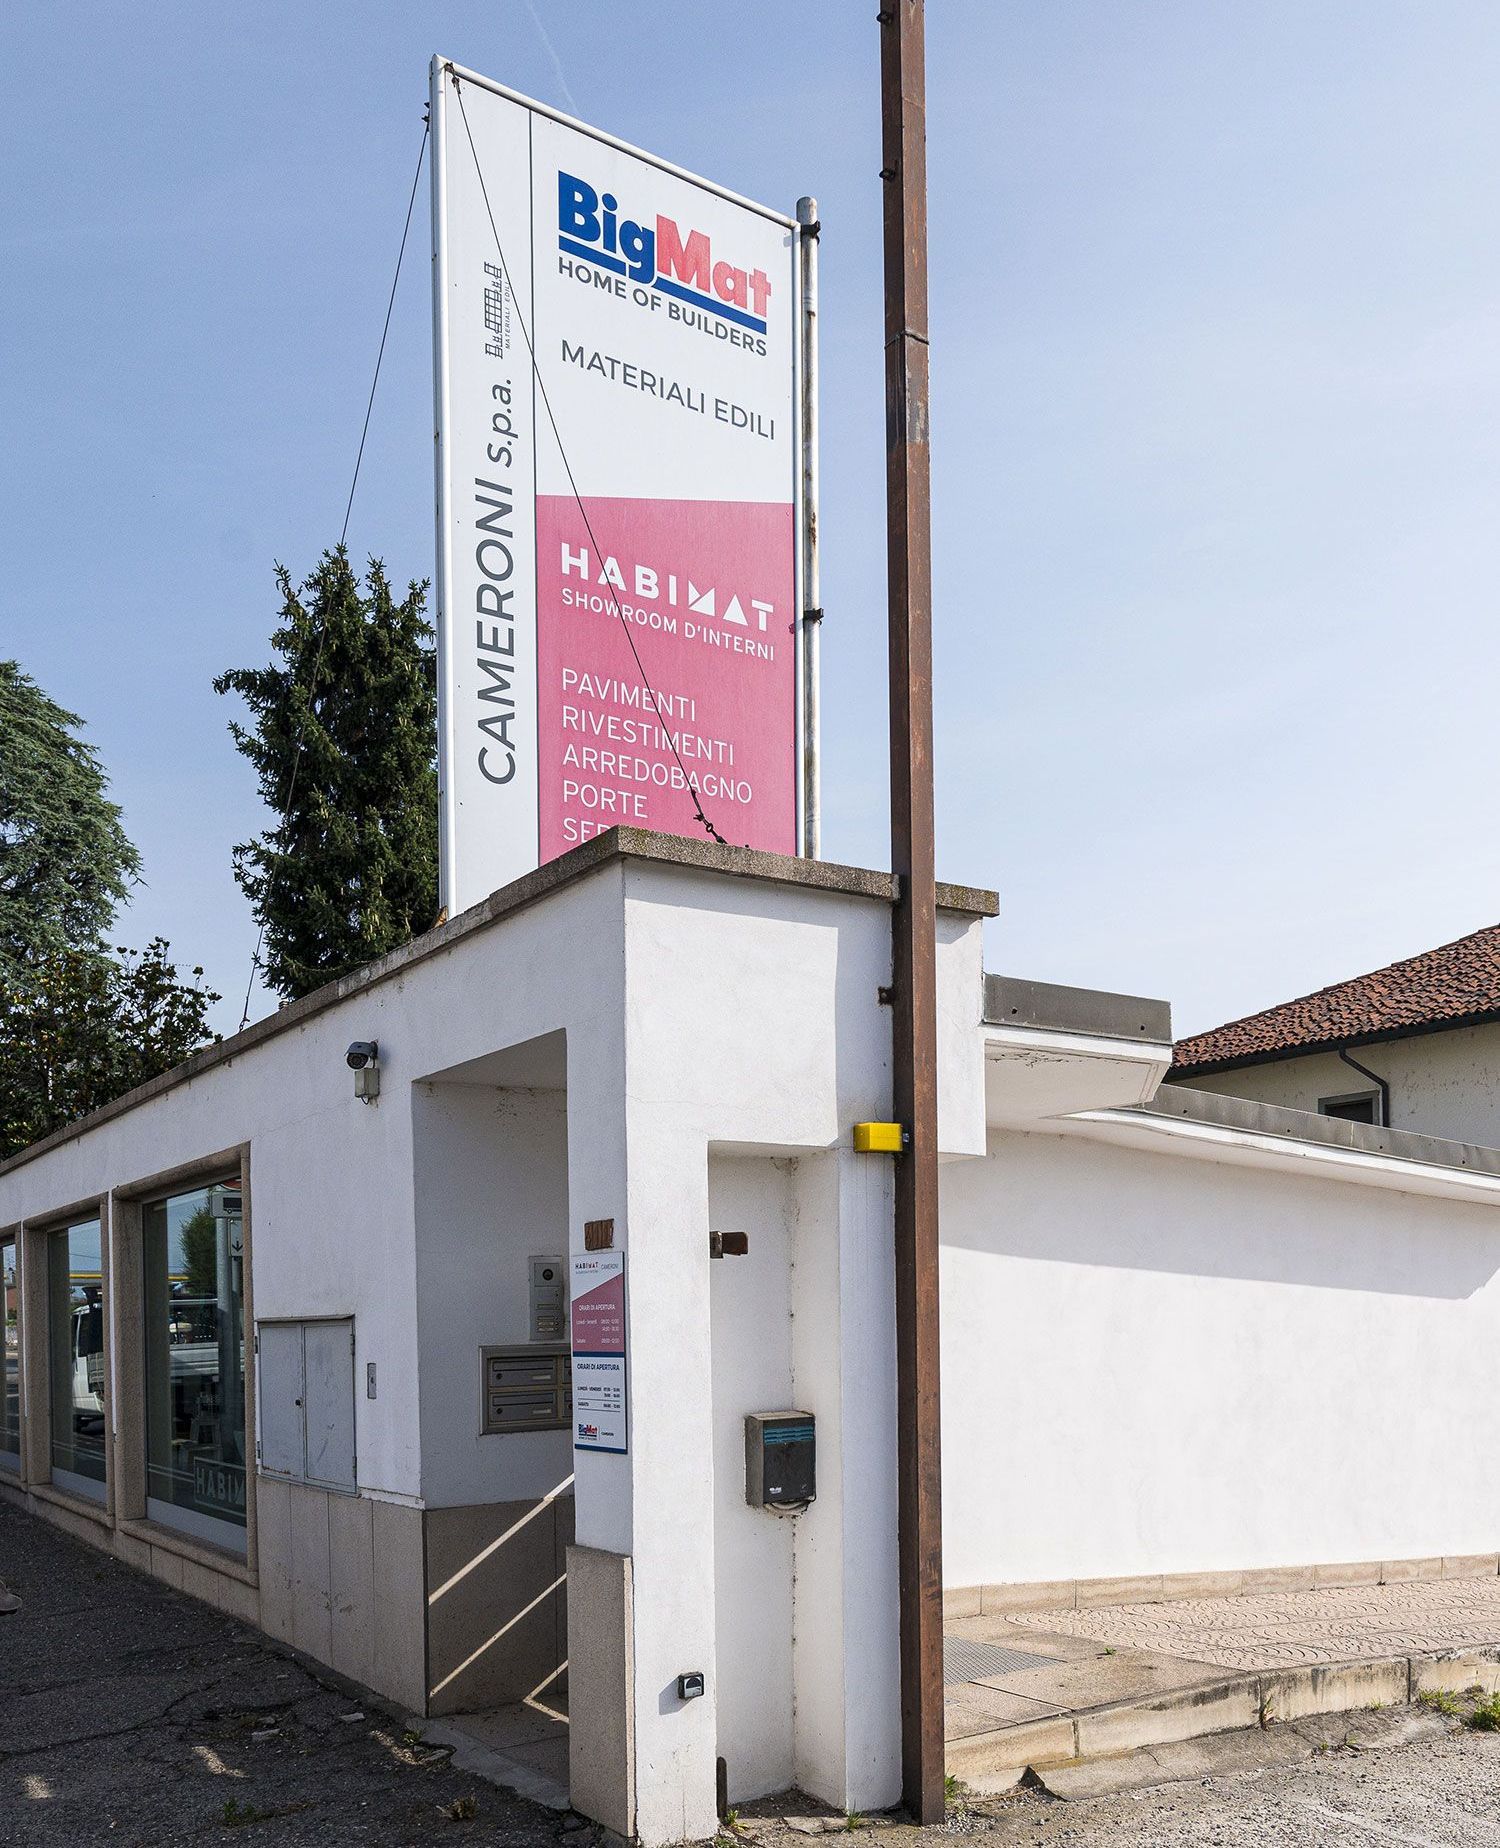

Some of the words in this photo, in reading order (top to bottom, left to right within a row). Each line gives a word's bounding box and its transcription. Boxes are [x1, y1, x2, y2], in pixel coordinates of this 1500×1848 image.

[558, 170, 772, 318] BigMat
[558, 256, 627, 299] HOME
[632, 287, 662, 313] OF
[667, 301, 768, 358] BUILDERS
[561, 339, 705, 415] MATERIALI
[714, 398, 775, 440] EDILI
[560, 542, 775, 632] HABIMAT
[475, 477, 516, 785] CAMERONI
[561, 588, 677, 635] SHOWROOM
[684, 622, 775, 662] D'INTERNI
[562, 667, 696, 722] PAVIMENTI
[562, 705, 735, 766] RIVESTIMENTI
[562, 744, 753, 805] ARREDOBAGNO
[562, 780, 648, 818] PORTE
[596, 1363, 620, 1371] APERTURA
